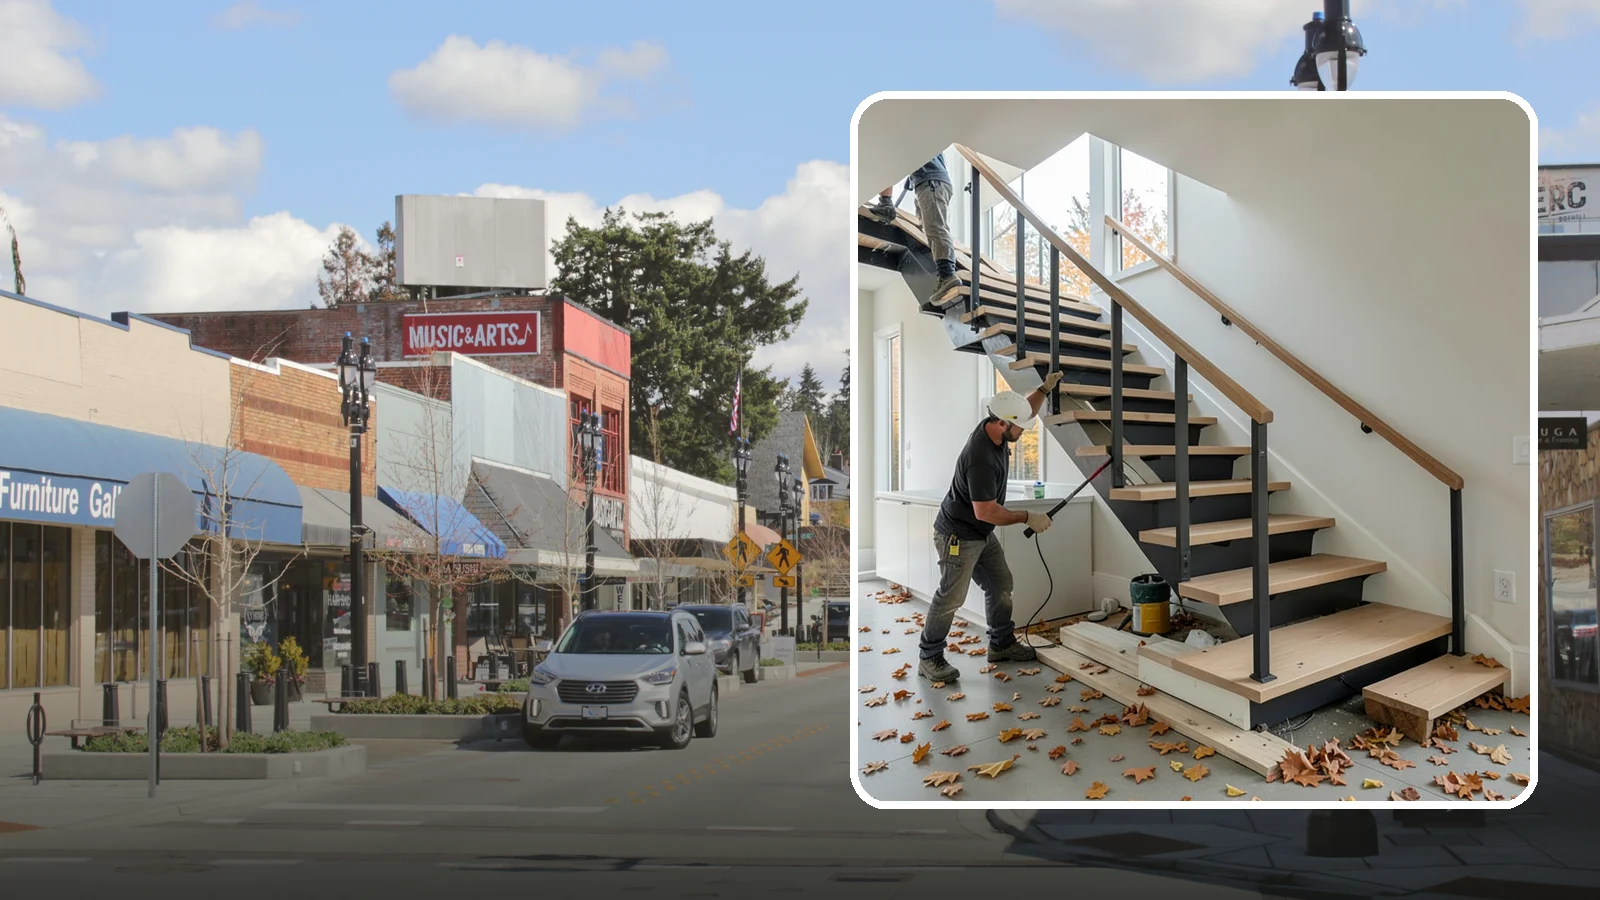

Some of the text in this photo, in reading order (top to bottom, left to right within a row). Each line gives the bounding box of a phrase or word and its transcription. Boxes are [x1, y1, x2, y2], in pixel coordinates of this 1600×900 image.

[409, 323, 519, 348] MUSIC&ARTS
[0, 471, 79, 515] Furniture
[454, 563, 479, 574] SUSHI
